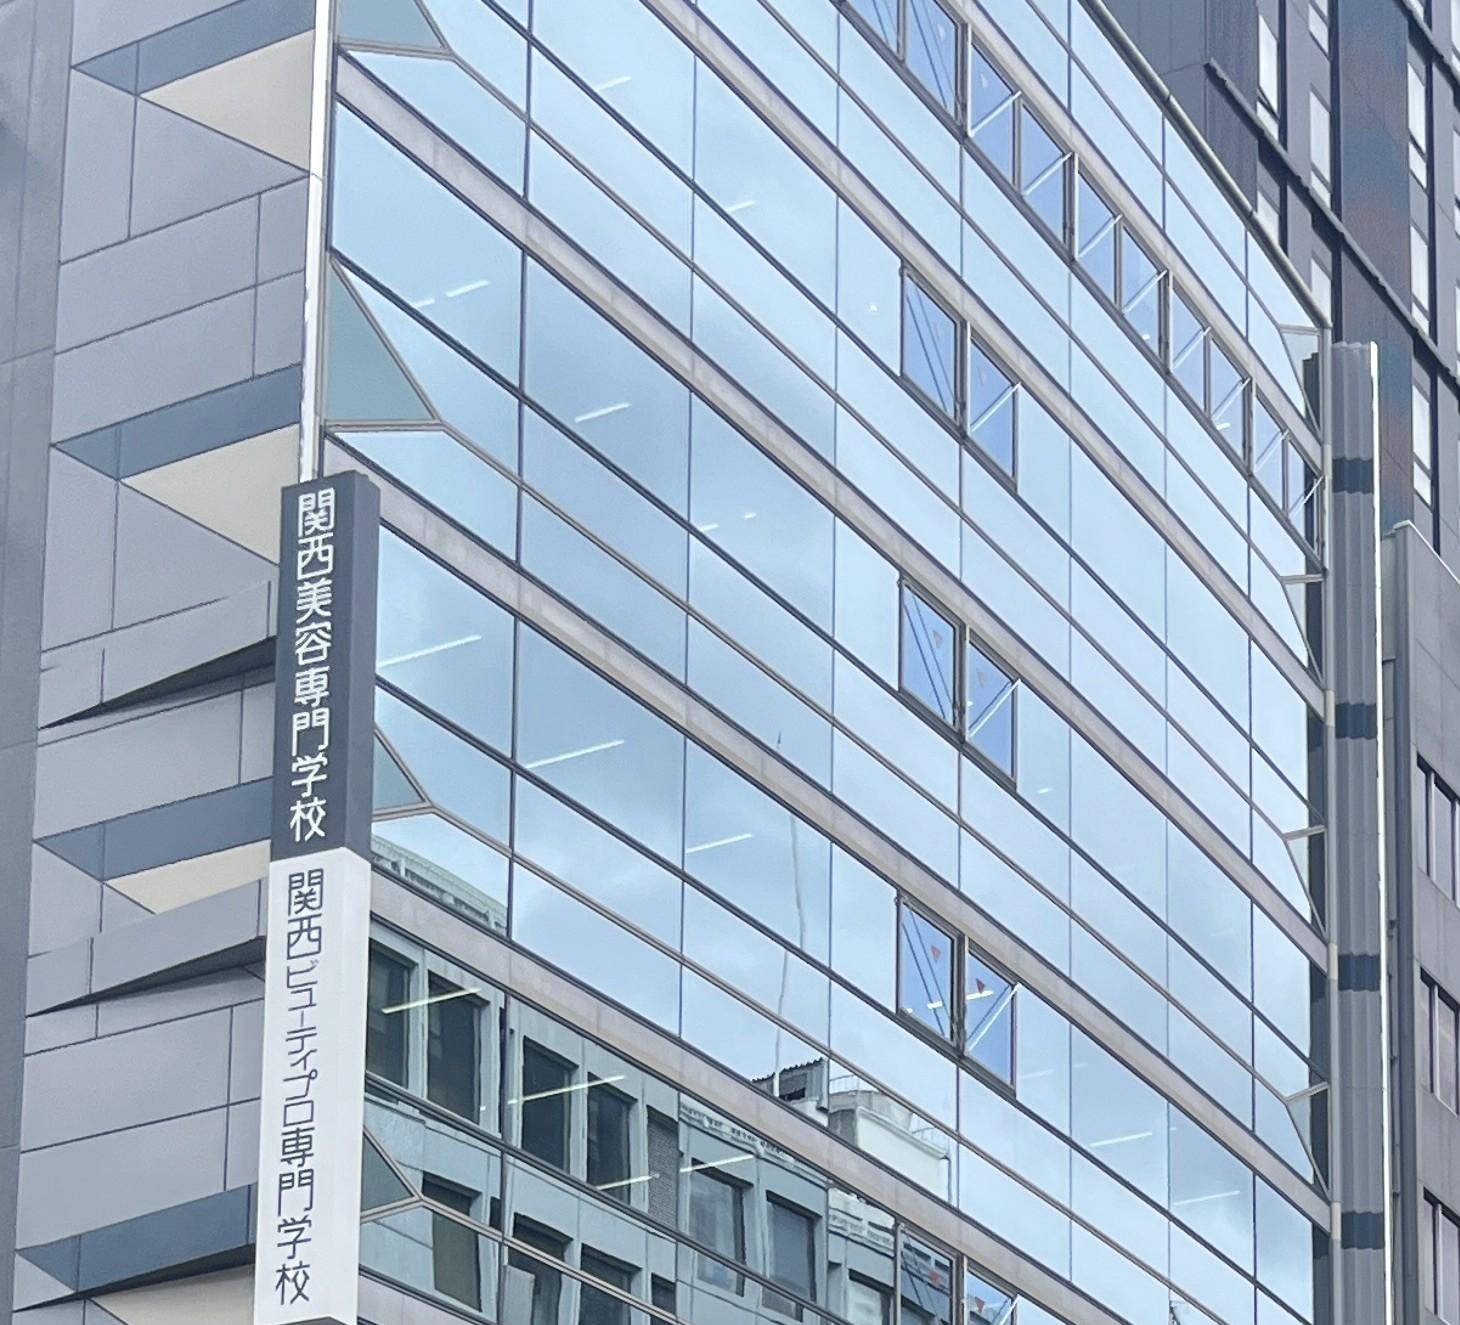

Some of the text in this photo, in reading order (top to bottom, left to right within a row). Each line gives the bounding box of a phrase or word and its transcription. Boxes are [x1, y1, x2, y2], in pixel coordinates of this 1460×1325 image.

[289, 486, 336, 843] 関西美容専門学校
[275, 867, 325, 1306] 関西ビューティプロ専門学校
